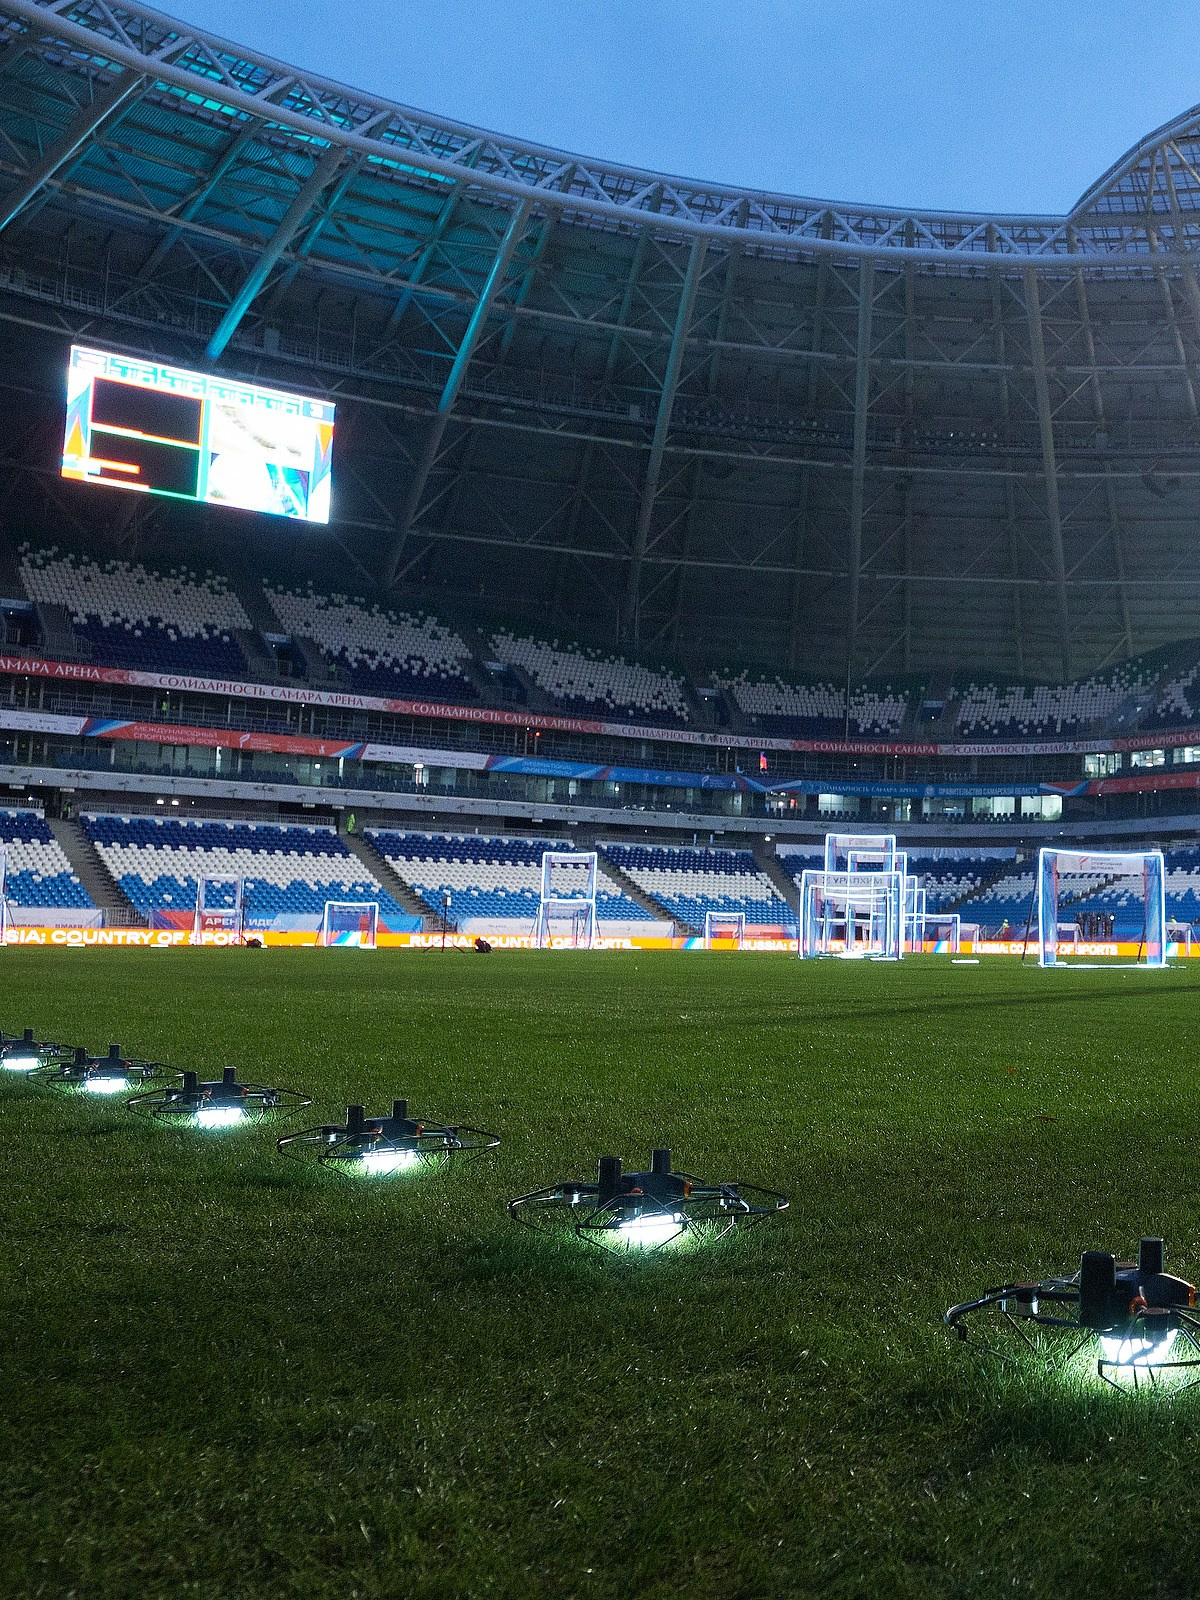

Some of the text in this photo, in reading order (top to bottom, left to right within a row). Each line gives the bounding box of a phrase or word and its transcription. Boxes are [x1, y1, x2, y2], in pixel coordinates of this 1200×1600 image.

[54, 665, 100, 679] АРЕНА
[159, 676, 364, 707] СОЛИДАРНОСТЬ САМАРА АРЕНА
[412, 704, 582, 730] СОЛИДАРНОСТЬ САМАРА АРЕНА
[621, 727, 698, 741] СОЛИДАРНОСТЬ
[744, 738, 774, 748] АРЕНА
[814, 742, 934, 754] СОЛИДАРНОСТЬ САМАРА
[51, 930, 154, 944] COUNTRY
[157, 932, 185, 945] OF
[410, 935, 473, 948] RUSSIA:
[972, 944, 1008, 954] RUSSIA:
[1059, 944, 1071, 955] OF
[1075, 944, 1118, 956] SPORTS
